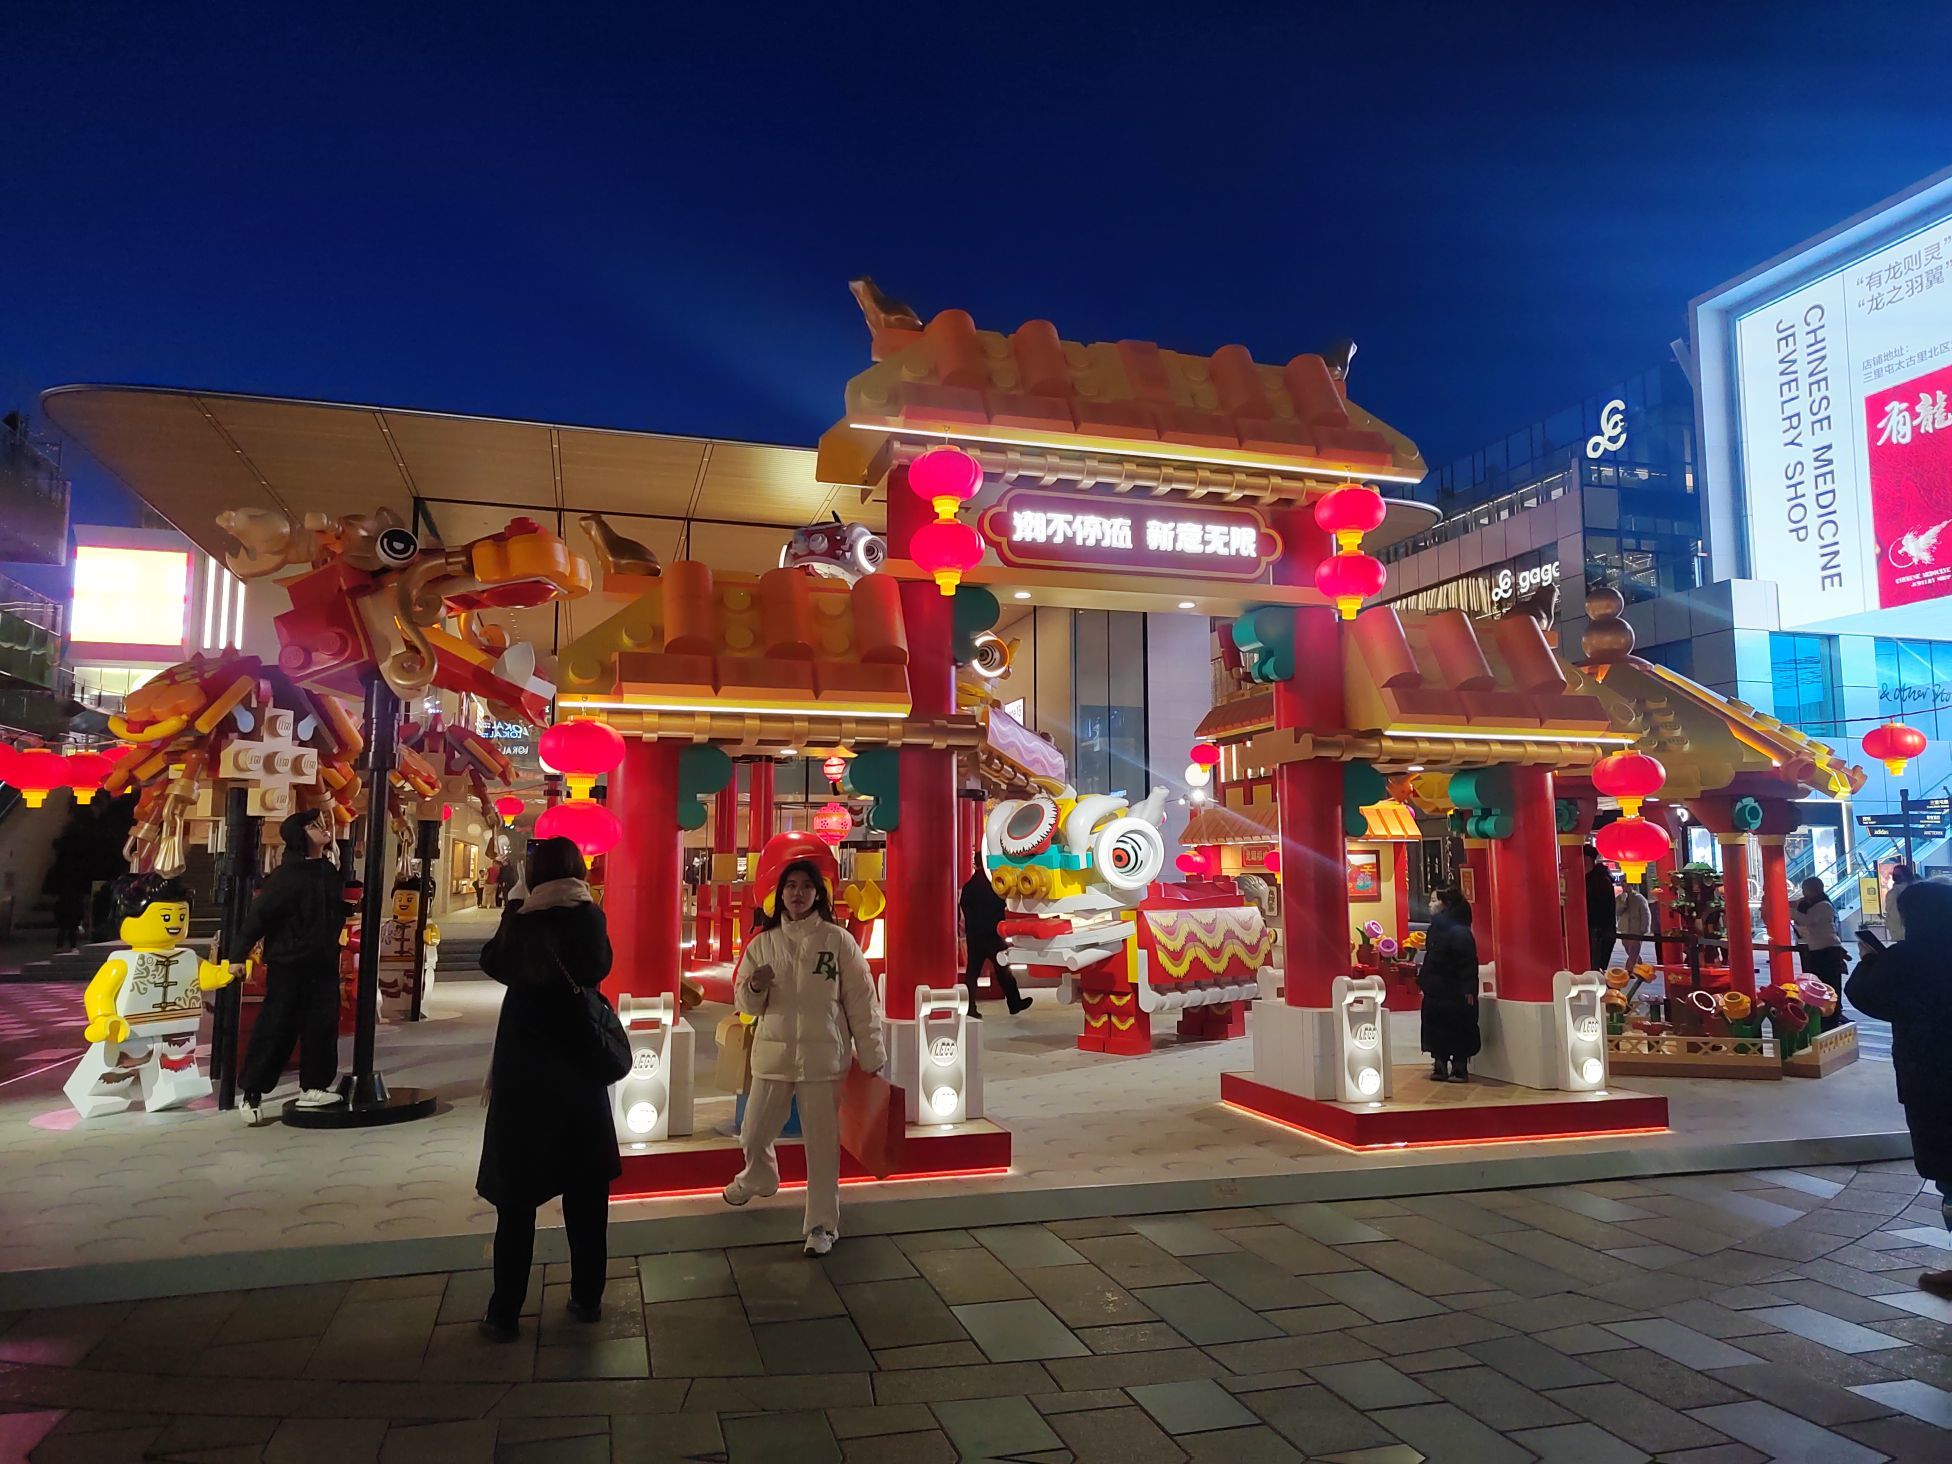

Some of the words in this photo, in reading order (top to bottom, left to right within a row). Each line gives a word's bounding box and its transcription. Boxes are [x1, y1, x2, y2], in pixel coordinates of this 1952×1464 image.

[1775, 318, 1803, 449] JEWELRY
[1803, 303, 1833, 437] CHINESE
[1863, 340, 1952, 384] 三里屯太古里北区
[1784, 468, 1809, 544] SHOP
[1812, 441, 1843, 592] MEDICINE
[1359, 1027, 1376, 1040] LEGO
[1582, 1021, 1599, 1033] LEGO
[633, 1053, 656, 1069] LEGO
[934, 1042, 955, 1057] LEGO
